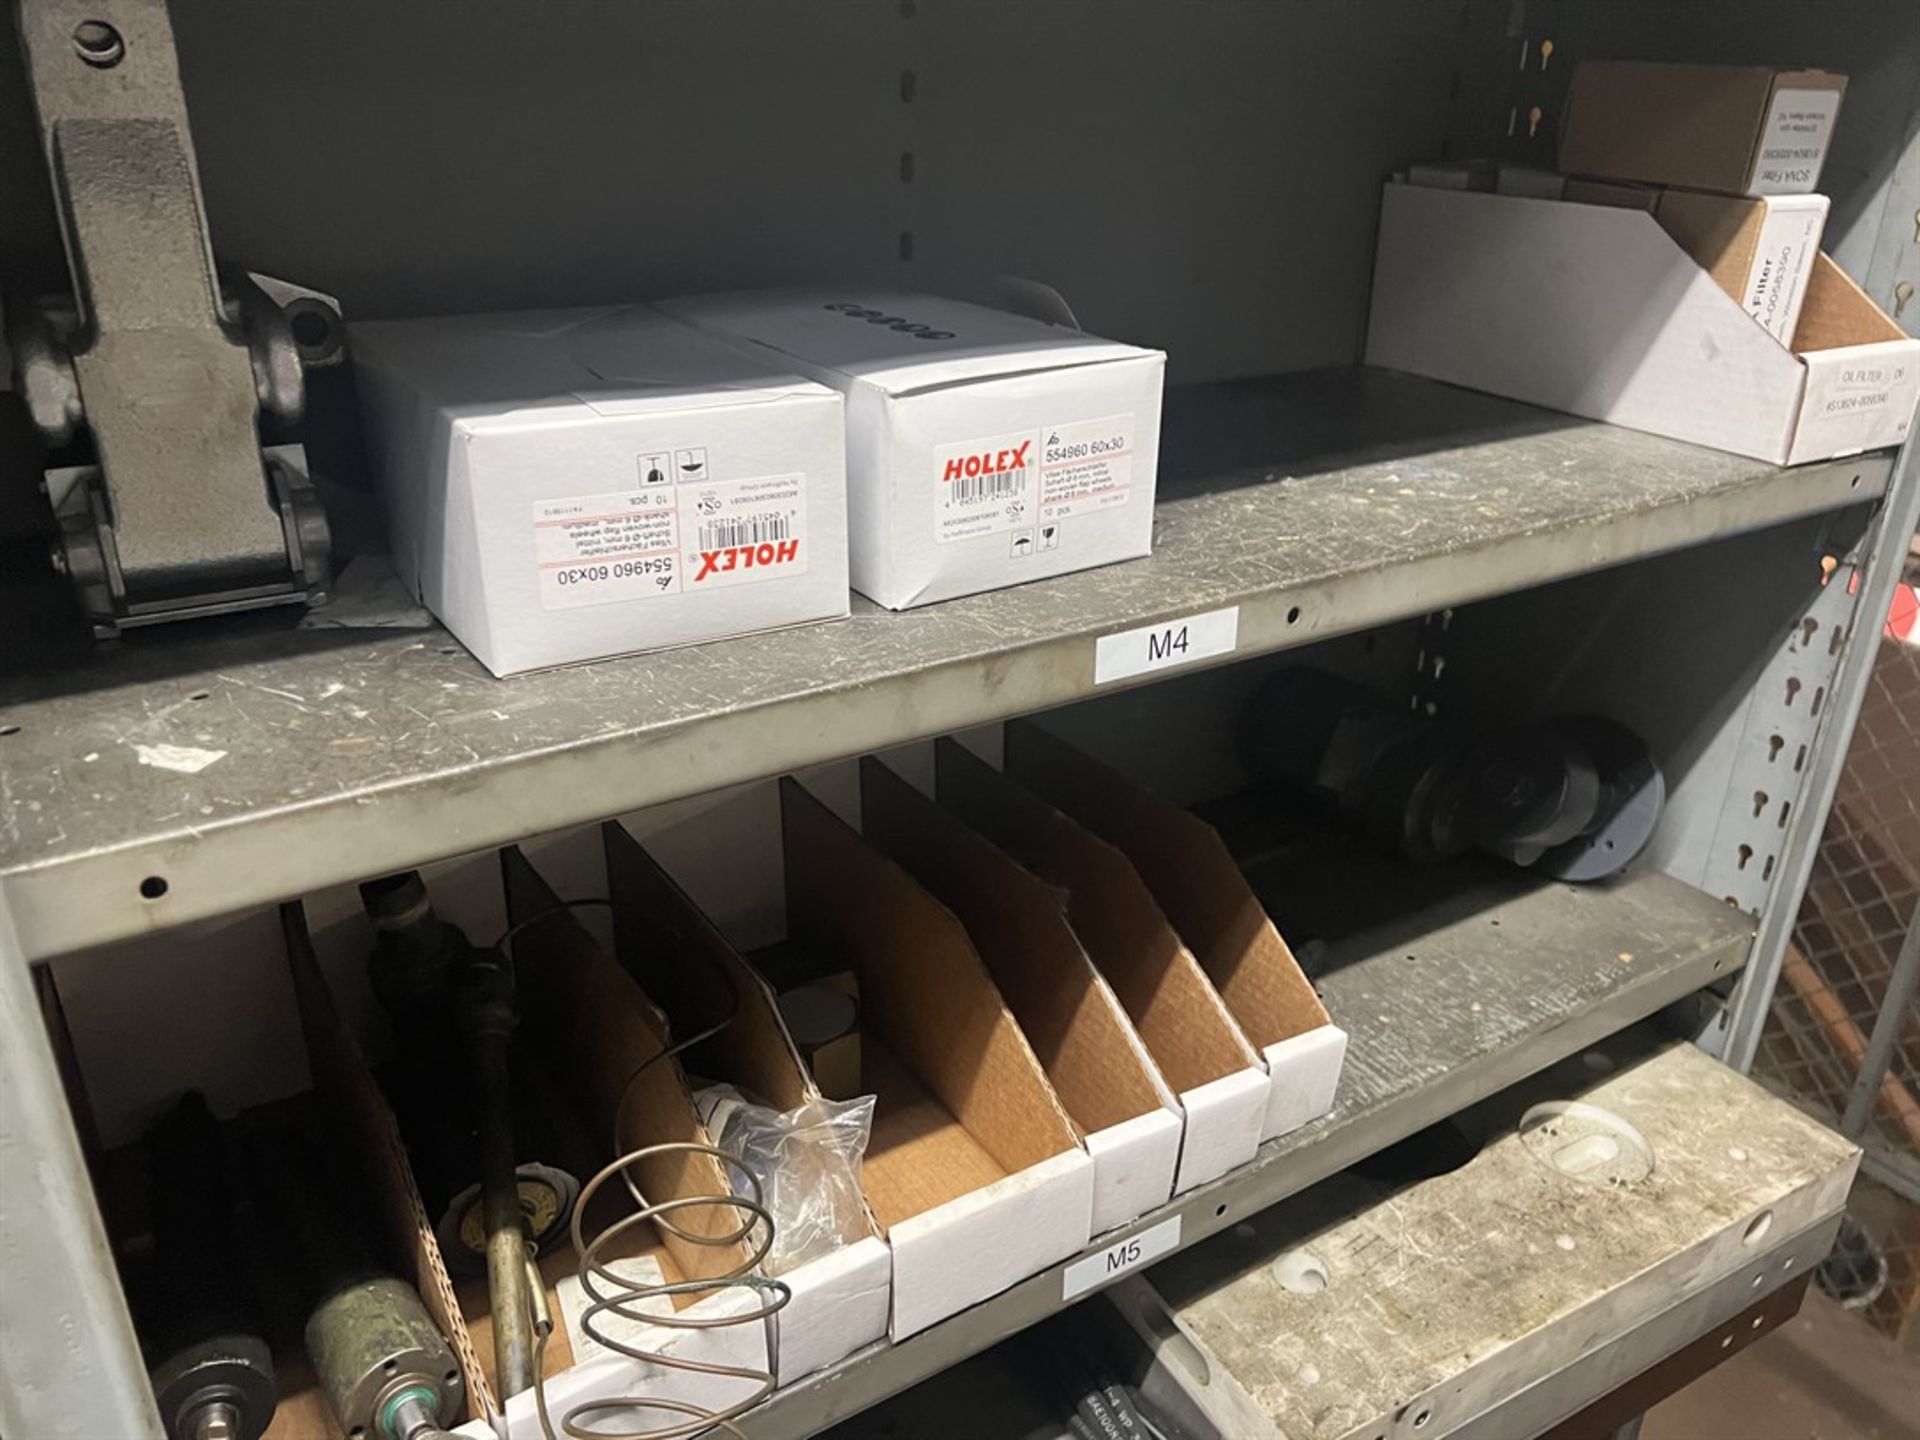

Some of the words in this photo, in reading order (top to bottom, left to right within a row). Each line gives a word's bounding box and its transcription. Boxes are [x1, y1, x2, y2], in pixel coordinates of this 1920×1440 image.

[943, 439, 1031, 482] HOLEX
[1046, 443, 1088, 463] 554960
[1090, 436, 1124, 455] 60x30
[655, 495, 668, 505] 10
[557, 566, 609, 585] 60x30
[613, 557, 673, 578] 554960
[694, 539, 799, 582] HOLEX
[1148, 626, 1189, 662] M4
[1105, 1239, 1141, 1273] M5
